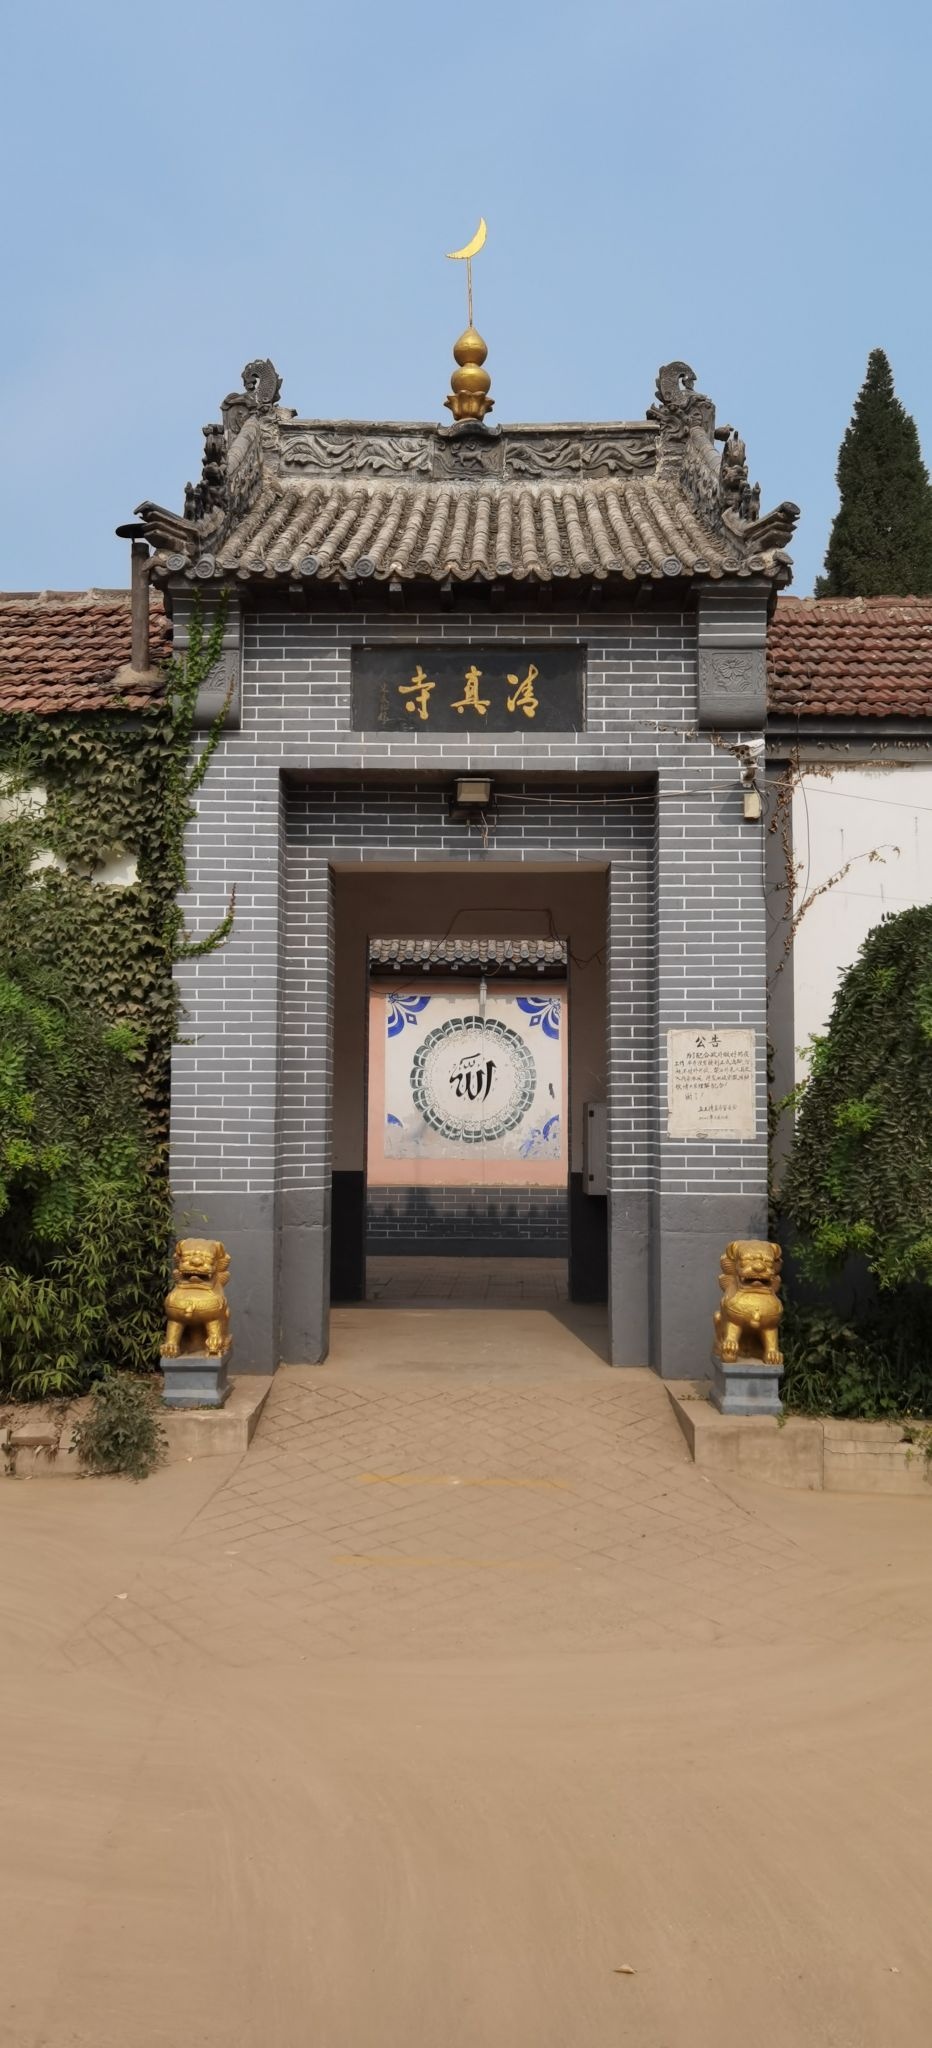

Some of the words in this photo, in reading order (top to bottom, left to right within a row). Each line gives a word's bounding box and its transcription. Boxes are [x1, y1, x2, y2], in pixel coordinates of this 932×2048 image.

[398, 663, 540, 720] 清真寺
[695, 1034, 722, 1048] 公告
